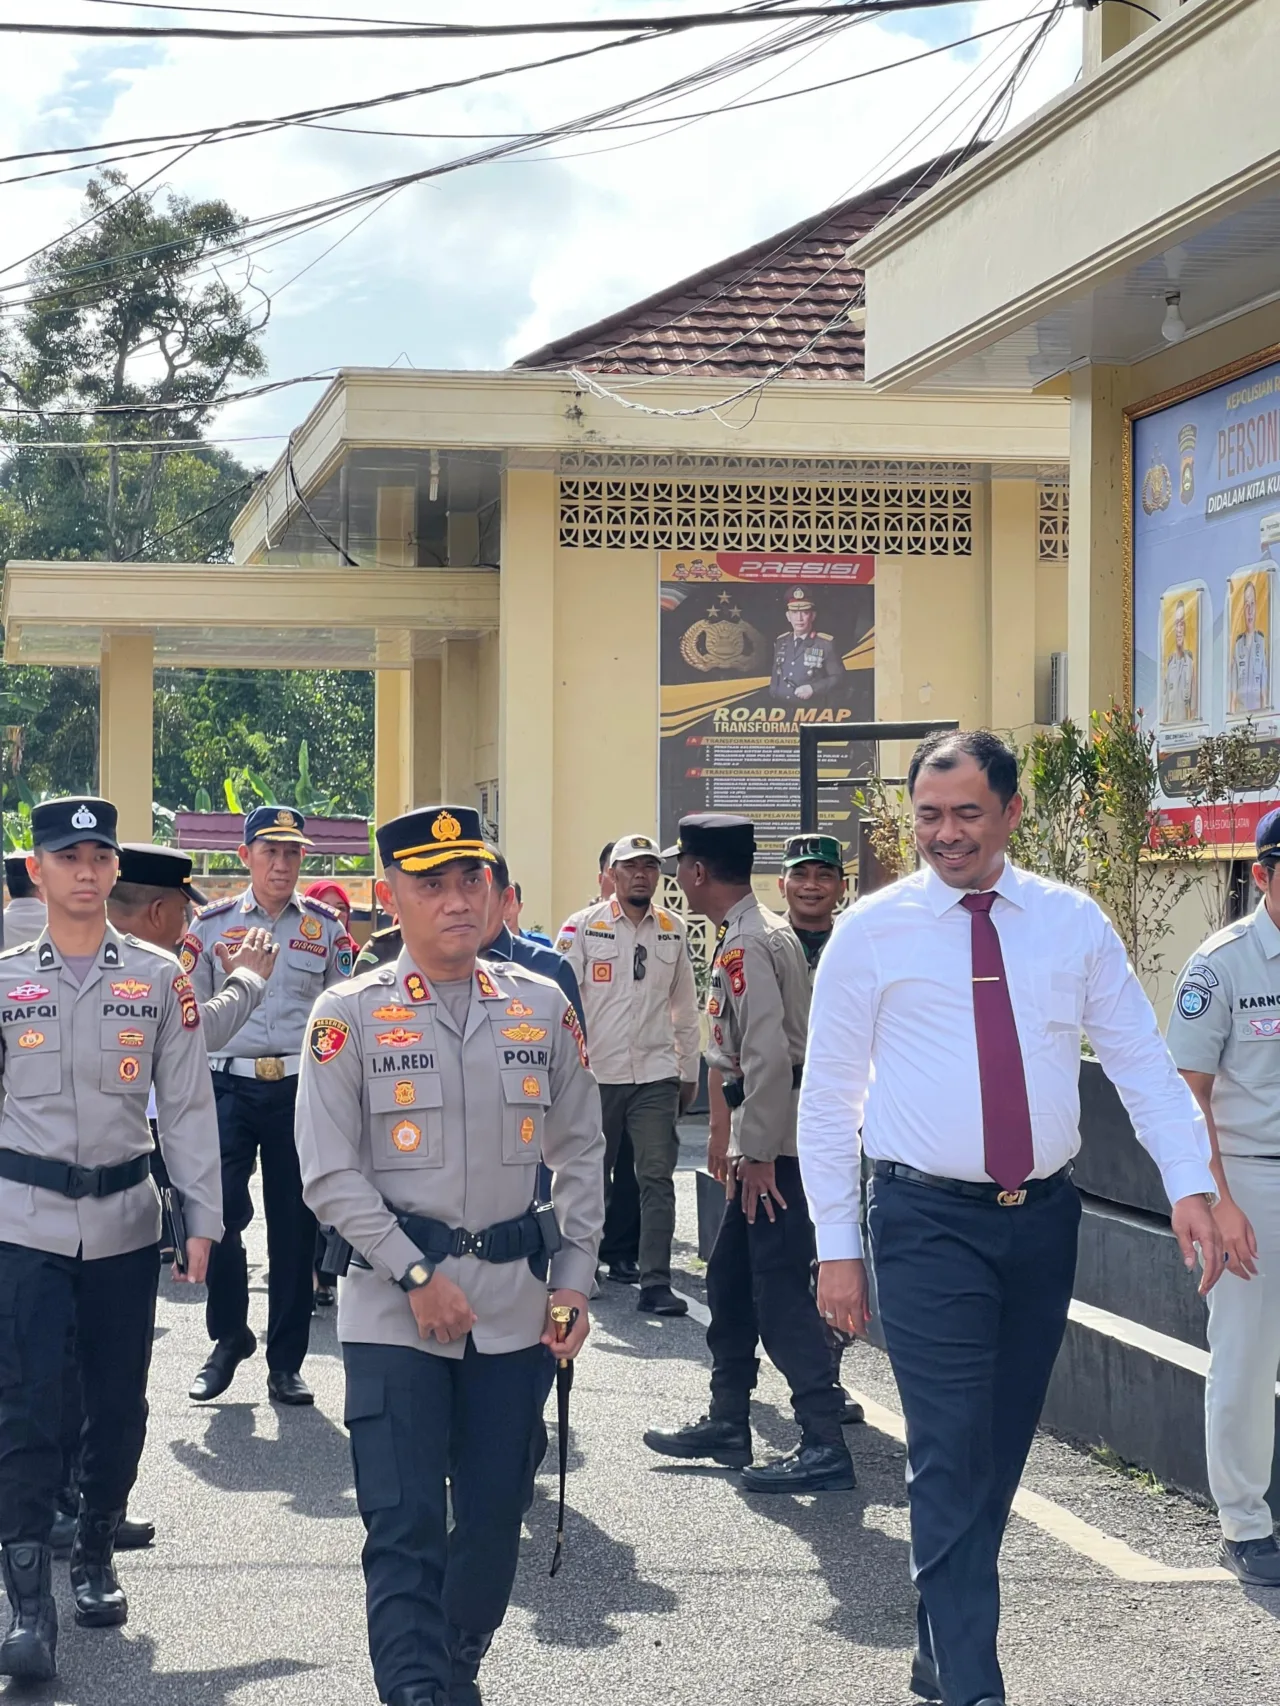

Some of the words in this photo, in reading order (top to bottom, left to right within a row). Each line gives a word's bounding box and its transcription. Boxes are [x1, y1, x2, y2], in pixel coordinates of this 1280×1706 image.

[1227, 380, 1273, 410] KEPOLISIAN
[1218, 408, 1280, 480] PERSON
[1207, 491, 1245, 513] DIDALAM
[1246, 480, 1265, 502] KITA
[739, 561, 860, 575] PRESISI
[713, 708, 786, 722] ROAD
[793, 709, 852, 722] MAP
[713, 722, 801, 733] TRANSFORMA
[292, 942, 325, 954] DISHUB
[2, 1005, 57, 1023] RAFQI
[103, 1004, 157, 1019] POLRI
[372, 1053, 434, 1074] I.M.REDI
[504, 1049, 548, 1066] POLRI
